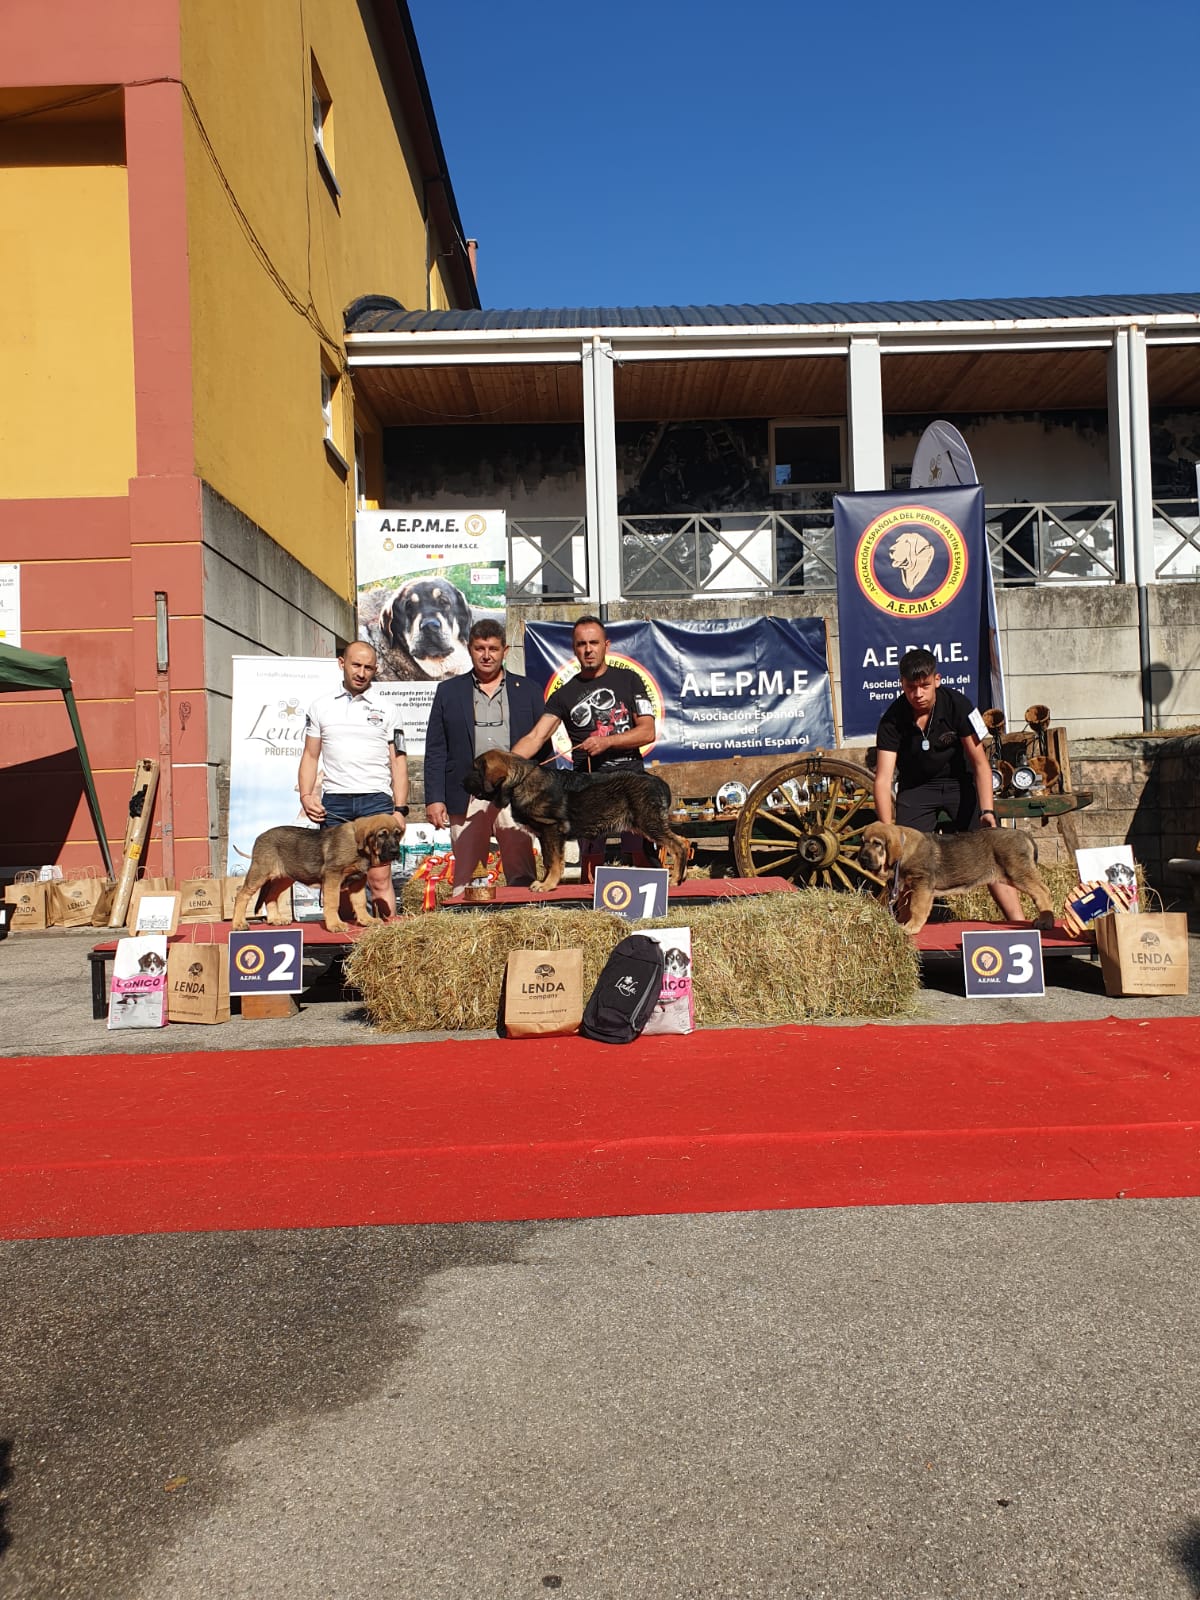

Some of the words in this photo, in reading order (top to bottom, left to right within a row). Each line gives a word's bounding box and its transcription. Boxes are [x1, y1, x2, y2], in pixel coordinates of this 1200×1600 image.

[900, 512, 914, 520] DEL
[916, 513, 941, 526] PERRO
[379, 518, 460, 533] A.E.P.M.E.
[866, 516, 898, 546] ESPAÑOLA
[939, 524, 959, 551] MASTÍN
[861, 546, 876, 593] ASOCIACIÓN
[949, 551, 961, 586] ESPAÑOL
[886, 597, 942, 614] A.E.P.M.E.
[680, 670, 818, 698] A.E.P.M.E.
[956, 674, 971, 684] del
[869, 691, 894, 701] Perro
[692, 710, 753, 722] Asociación
[740, 725, 759, 735] del
[692, 740, 722, 750] Perro
[764, 735, 810, 748] Español
[264, 747, 303, 757] PROFESIO
[67, 899, 91, 911] LENDA
[189, 900, 213, 908] LENDA
[638, 882, 658, 919] 1
[267, 943, 296, 982] 2
[1006, 943, 1034, 984] 3
[1131, 952, 1174, 965] LENDA
[174, 980, 205, 995] LENDA
[521, 981, 566, 994] LENDA
